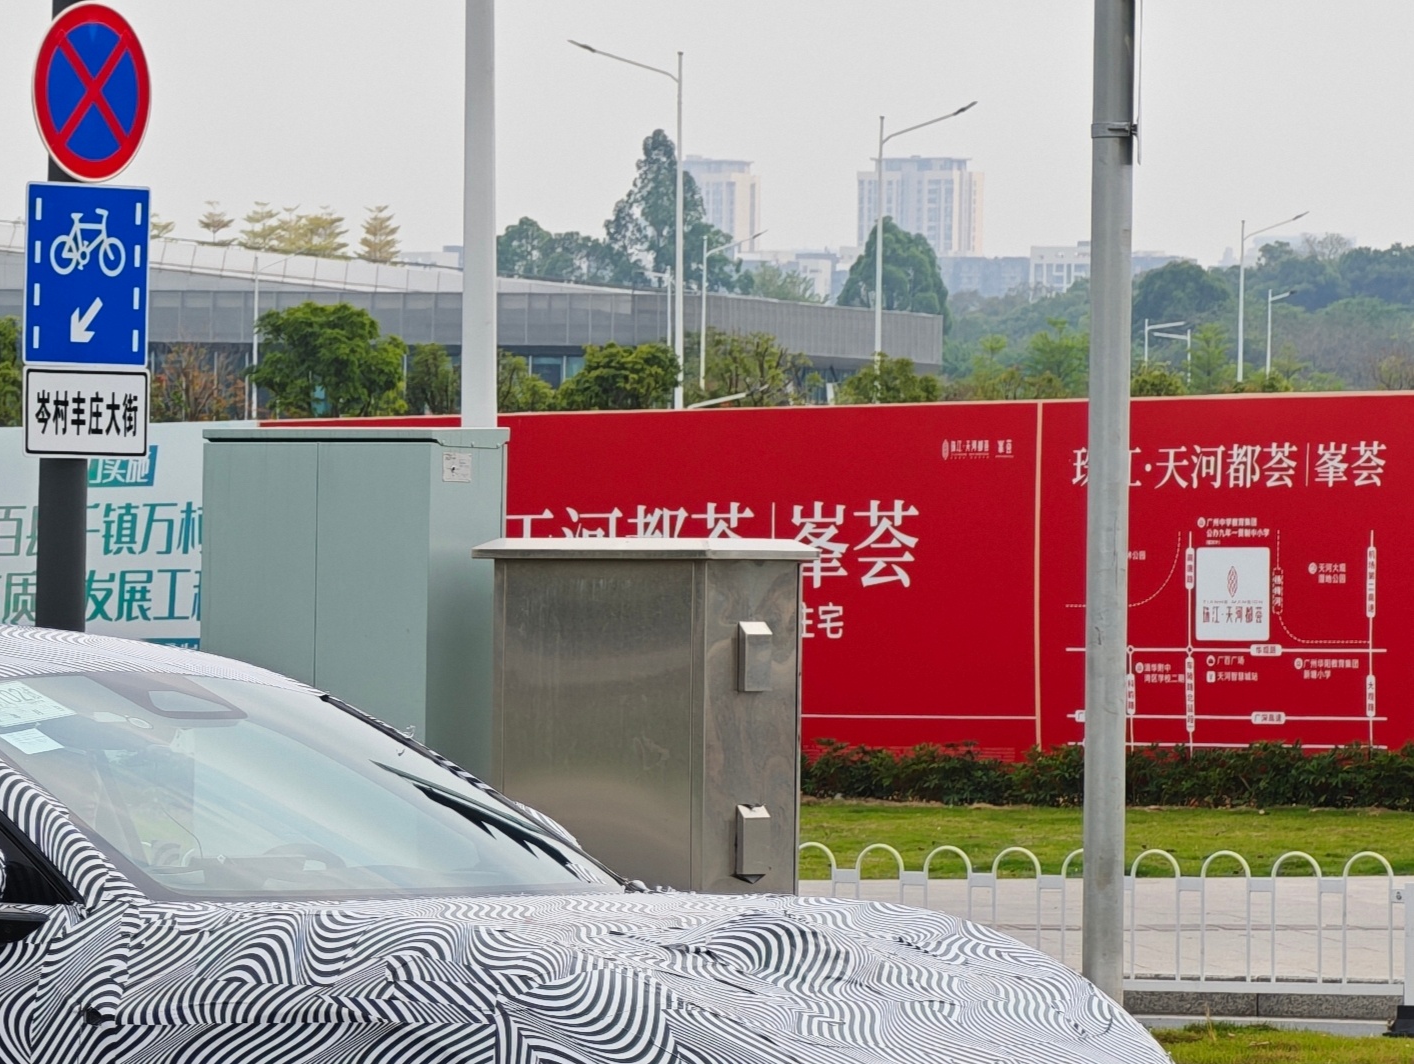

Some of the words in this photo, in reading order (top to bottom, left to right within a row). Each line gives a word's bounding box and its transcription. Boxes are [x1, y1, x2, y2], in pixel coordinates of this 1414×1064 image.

[35, 389, 138, 437] 岑村丰庄大街
